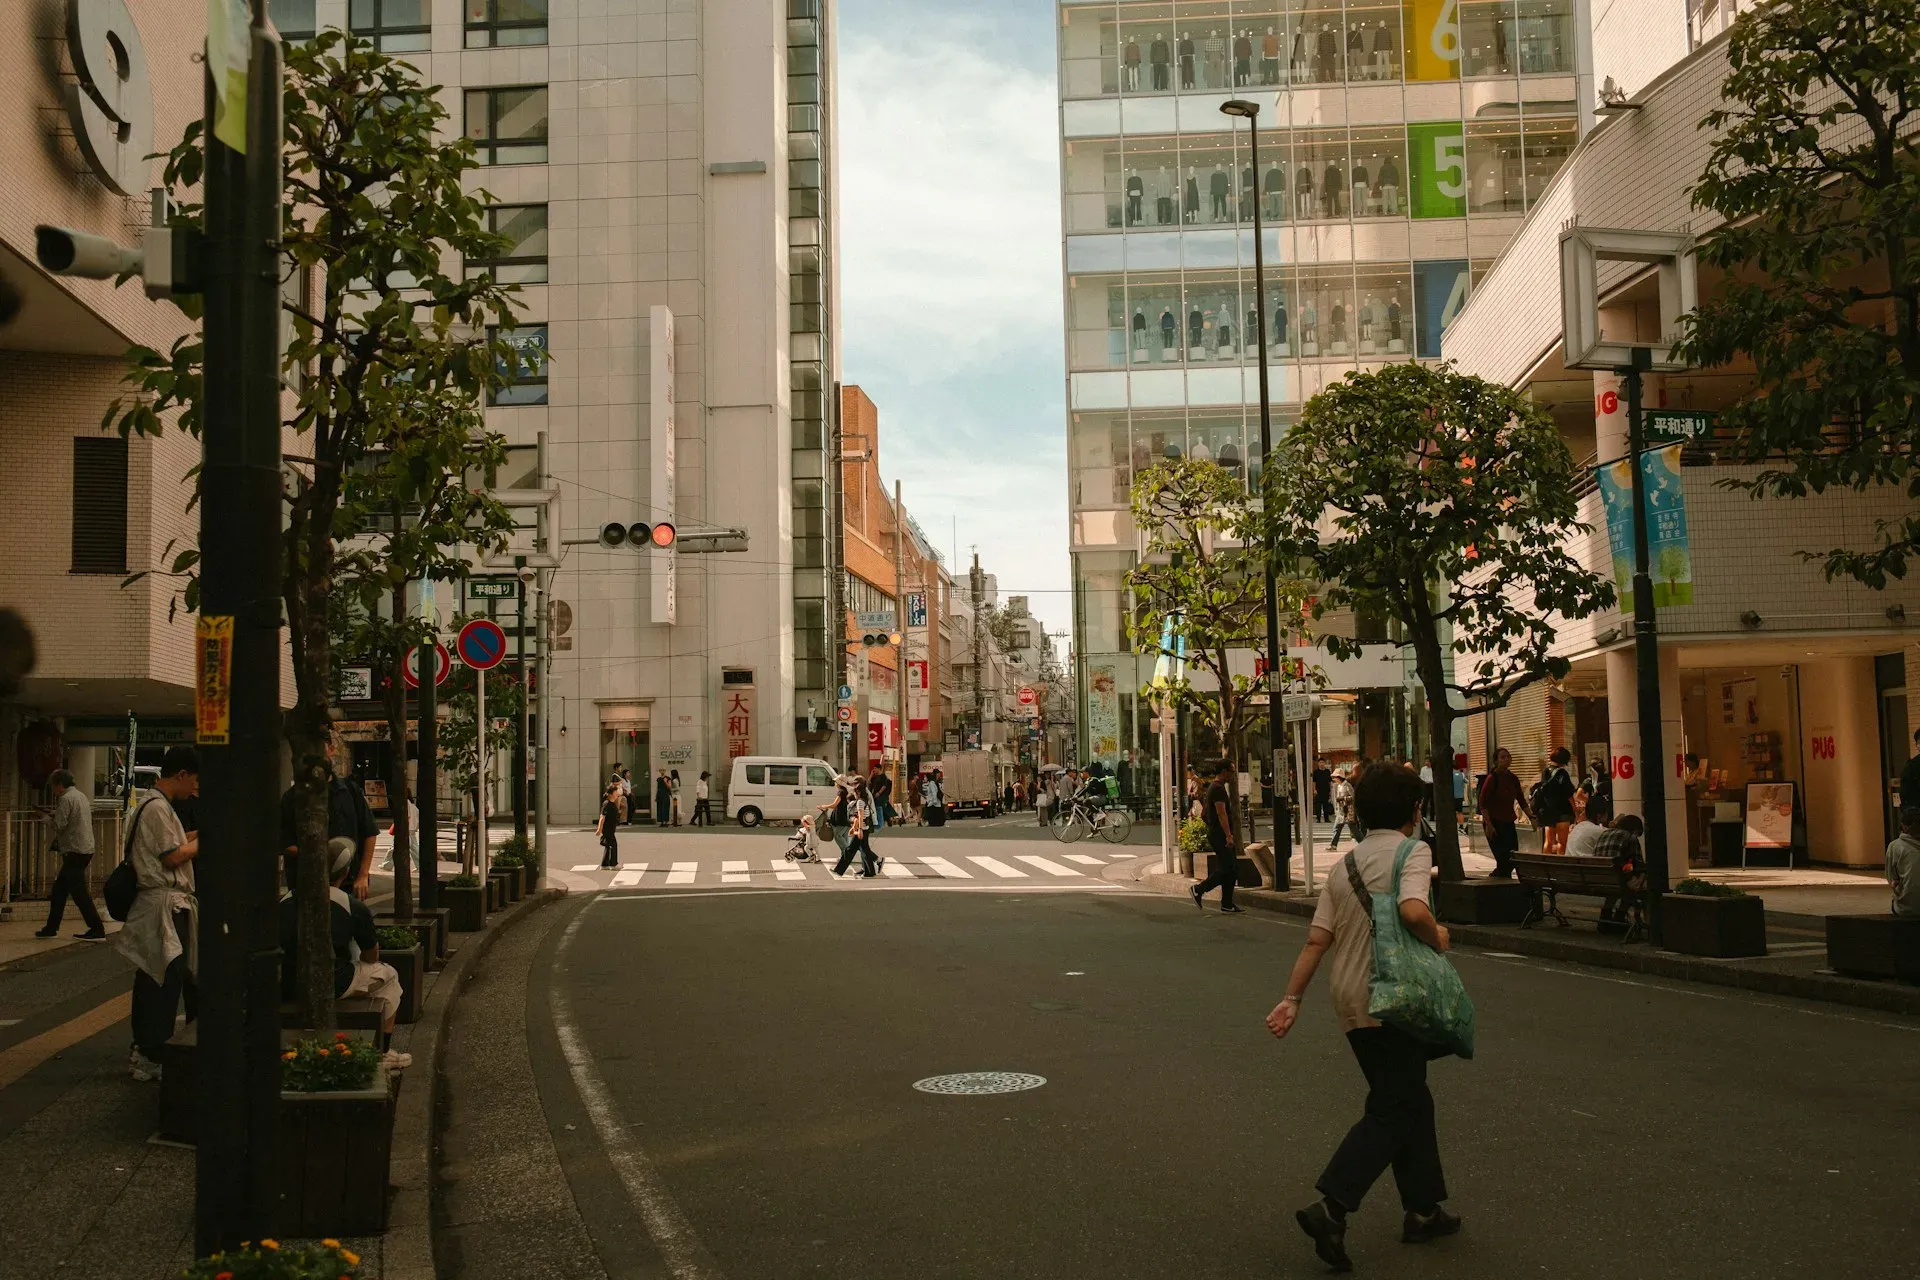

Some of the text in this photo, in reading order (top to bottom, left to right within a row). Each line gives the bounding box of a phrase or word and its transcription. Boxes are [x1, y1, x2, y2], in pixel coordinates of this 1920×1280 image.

[1434, 136, 1464, 198] 5
[1654, 417, 1706, 435] 平和通り
[475, 584, 510, 596] 平和通り
[660, 750, 692, 760] SAPIX
[1812, 735, 1835, 760] PUG
